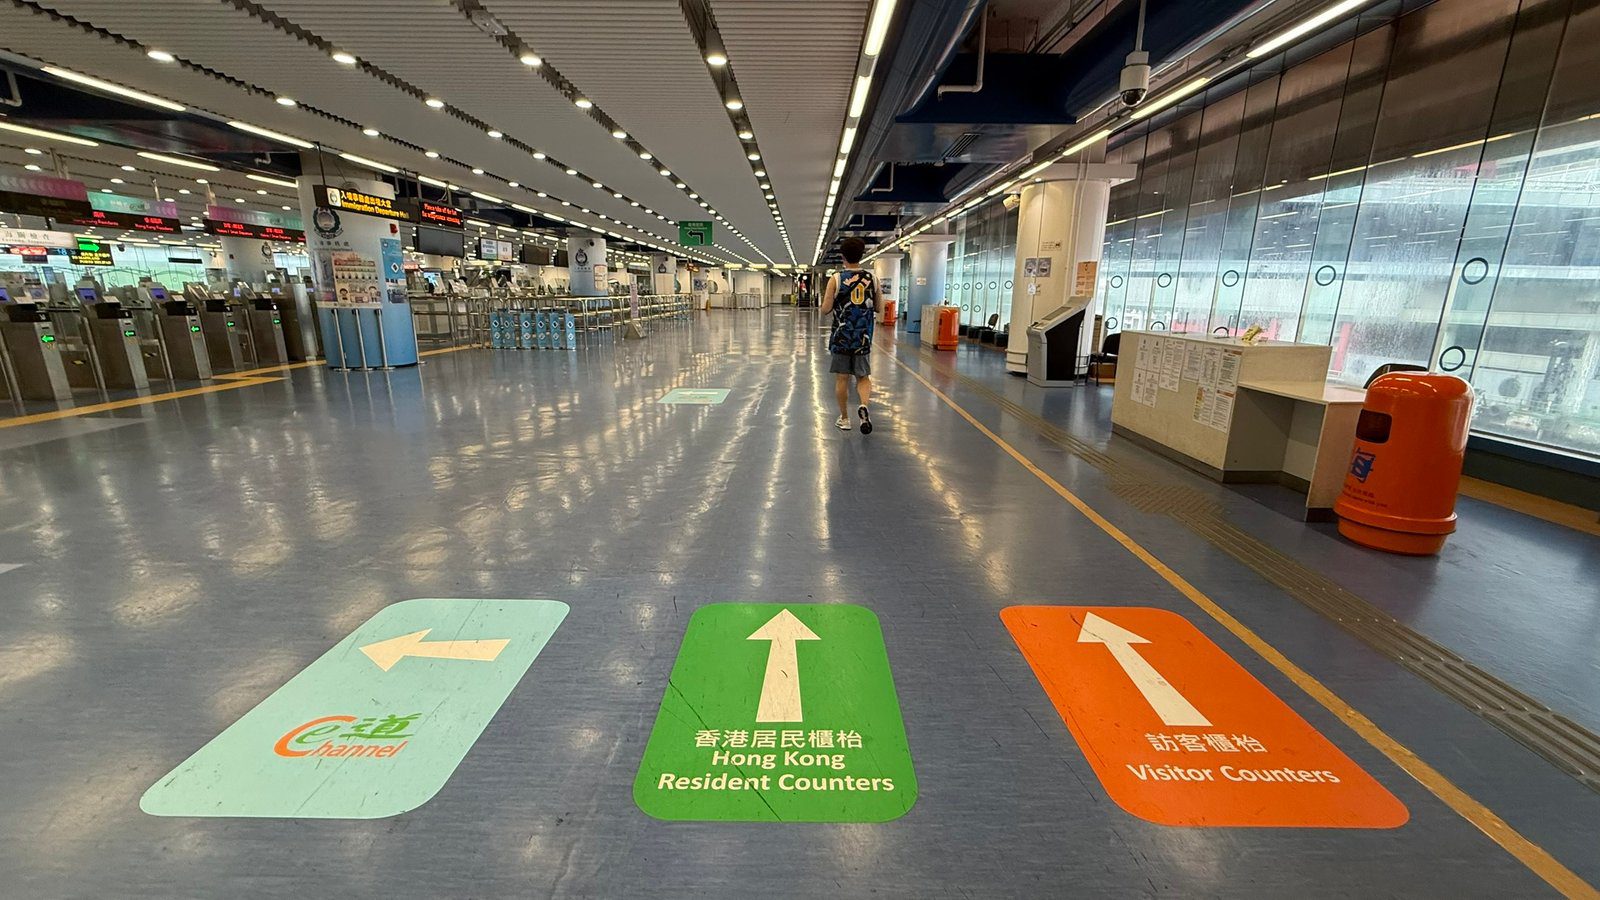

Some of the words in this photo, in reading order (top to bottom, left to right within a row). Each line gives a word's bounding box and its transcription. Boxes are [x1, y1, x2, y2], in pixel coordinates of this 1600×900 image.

[341, 200, 375, 212] Immigration
[375, 206, 399, 218] Departure
[850, 282, 865, 305] 0
[274, 715, 409, 758] Channel
[694, 730, 863, 749] 香港居民櫃枱
[1144, 732, 1268, 753] 訪客櫃枱
[712, 750, 776, 770] Hong
[784, 751, 846, 770] Kong
[657, 773, 771, 791] Resident
[778, 774, 895, 791] Counters
[1126, 763, 1215, 783] Visitor
[1220, 765, 1341, 784] Counters
